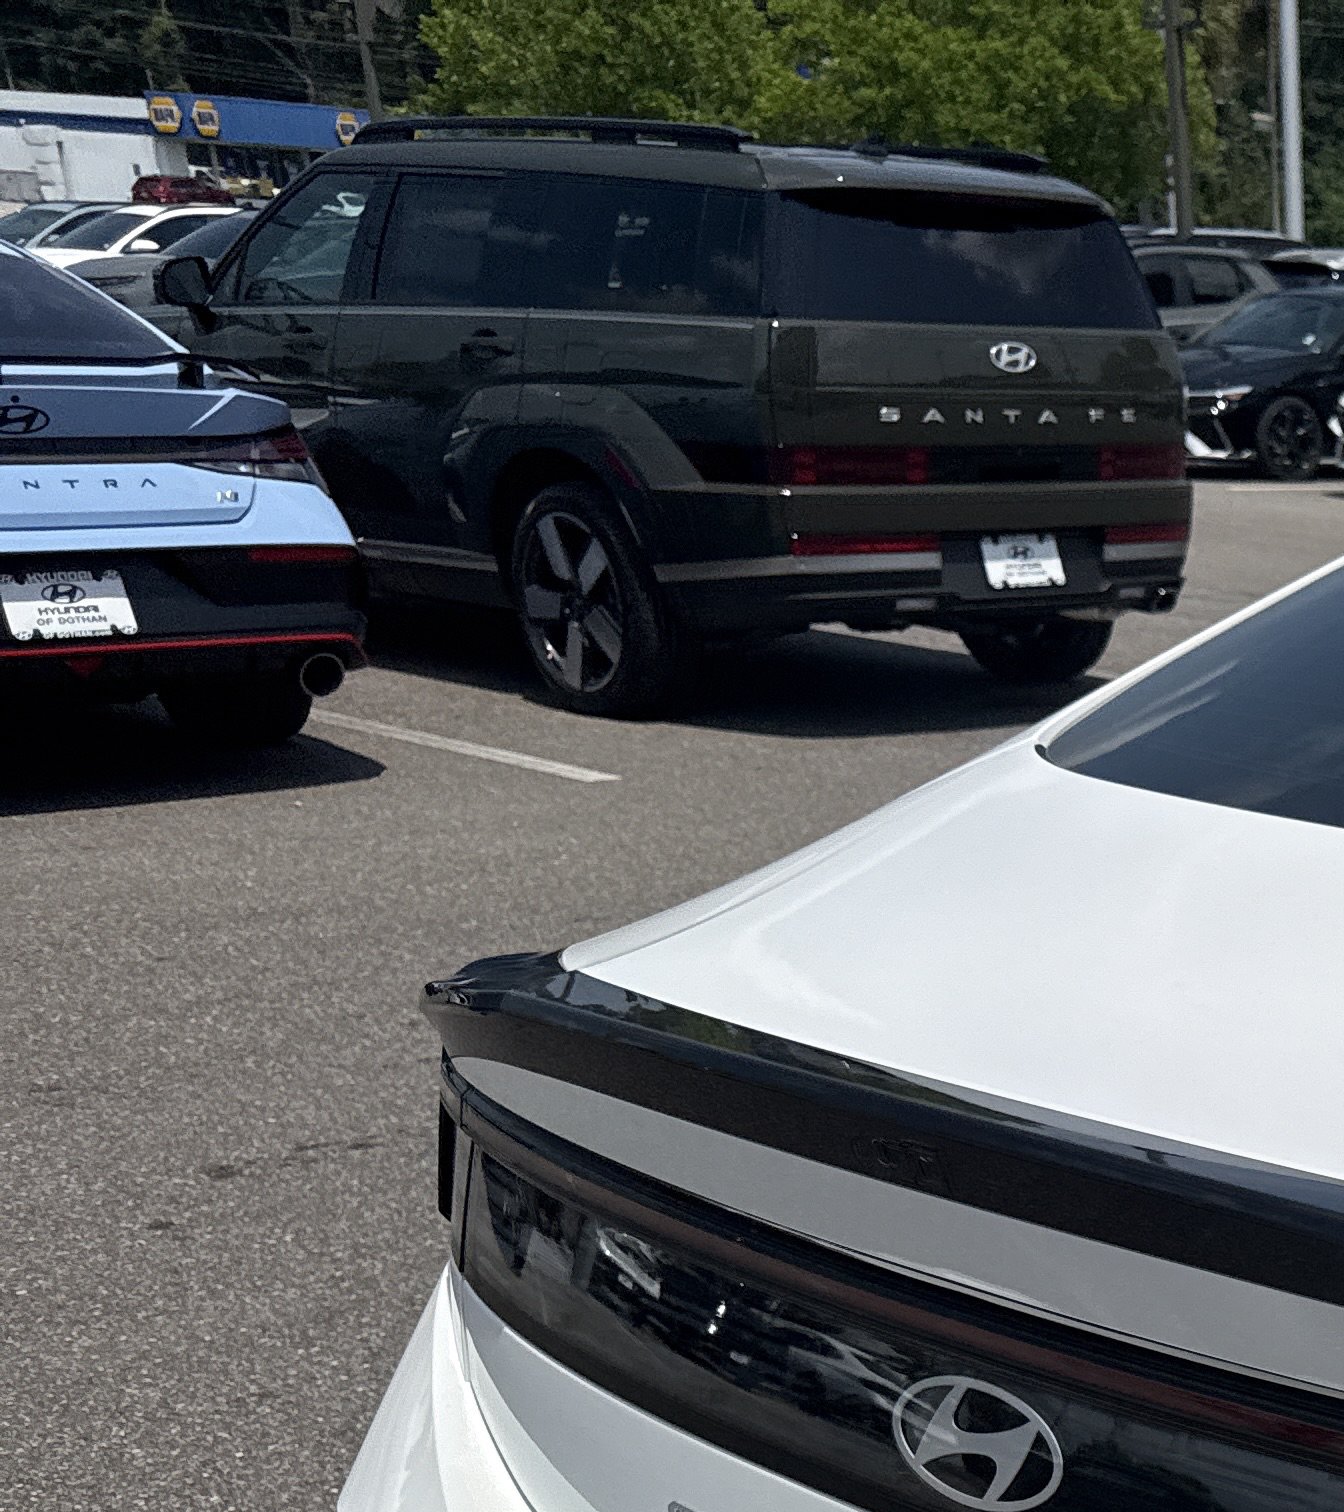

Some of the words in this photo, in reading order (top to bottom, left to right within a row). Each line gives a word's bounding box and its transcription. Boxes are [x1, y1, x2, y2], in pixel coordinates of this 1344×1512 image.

[879, 406, 1058, 425] SANTA
[1088, 407, 1137, 424] FE
[37, 605, 100, 616] HYUNDAI
[36, 617, 54, 627] OF
[58, 614, 108, 625] DOTHAN
